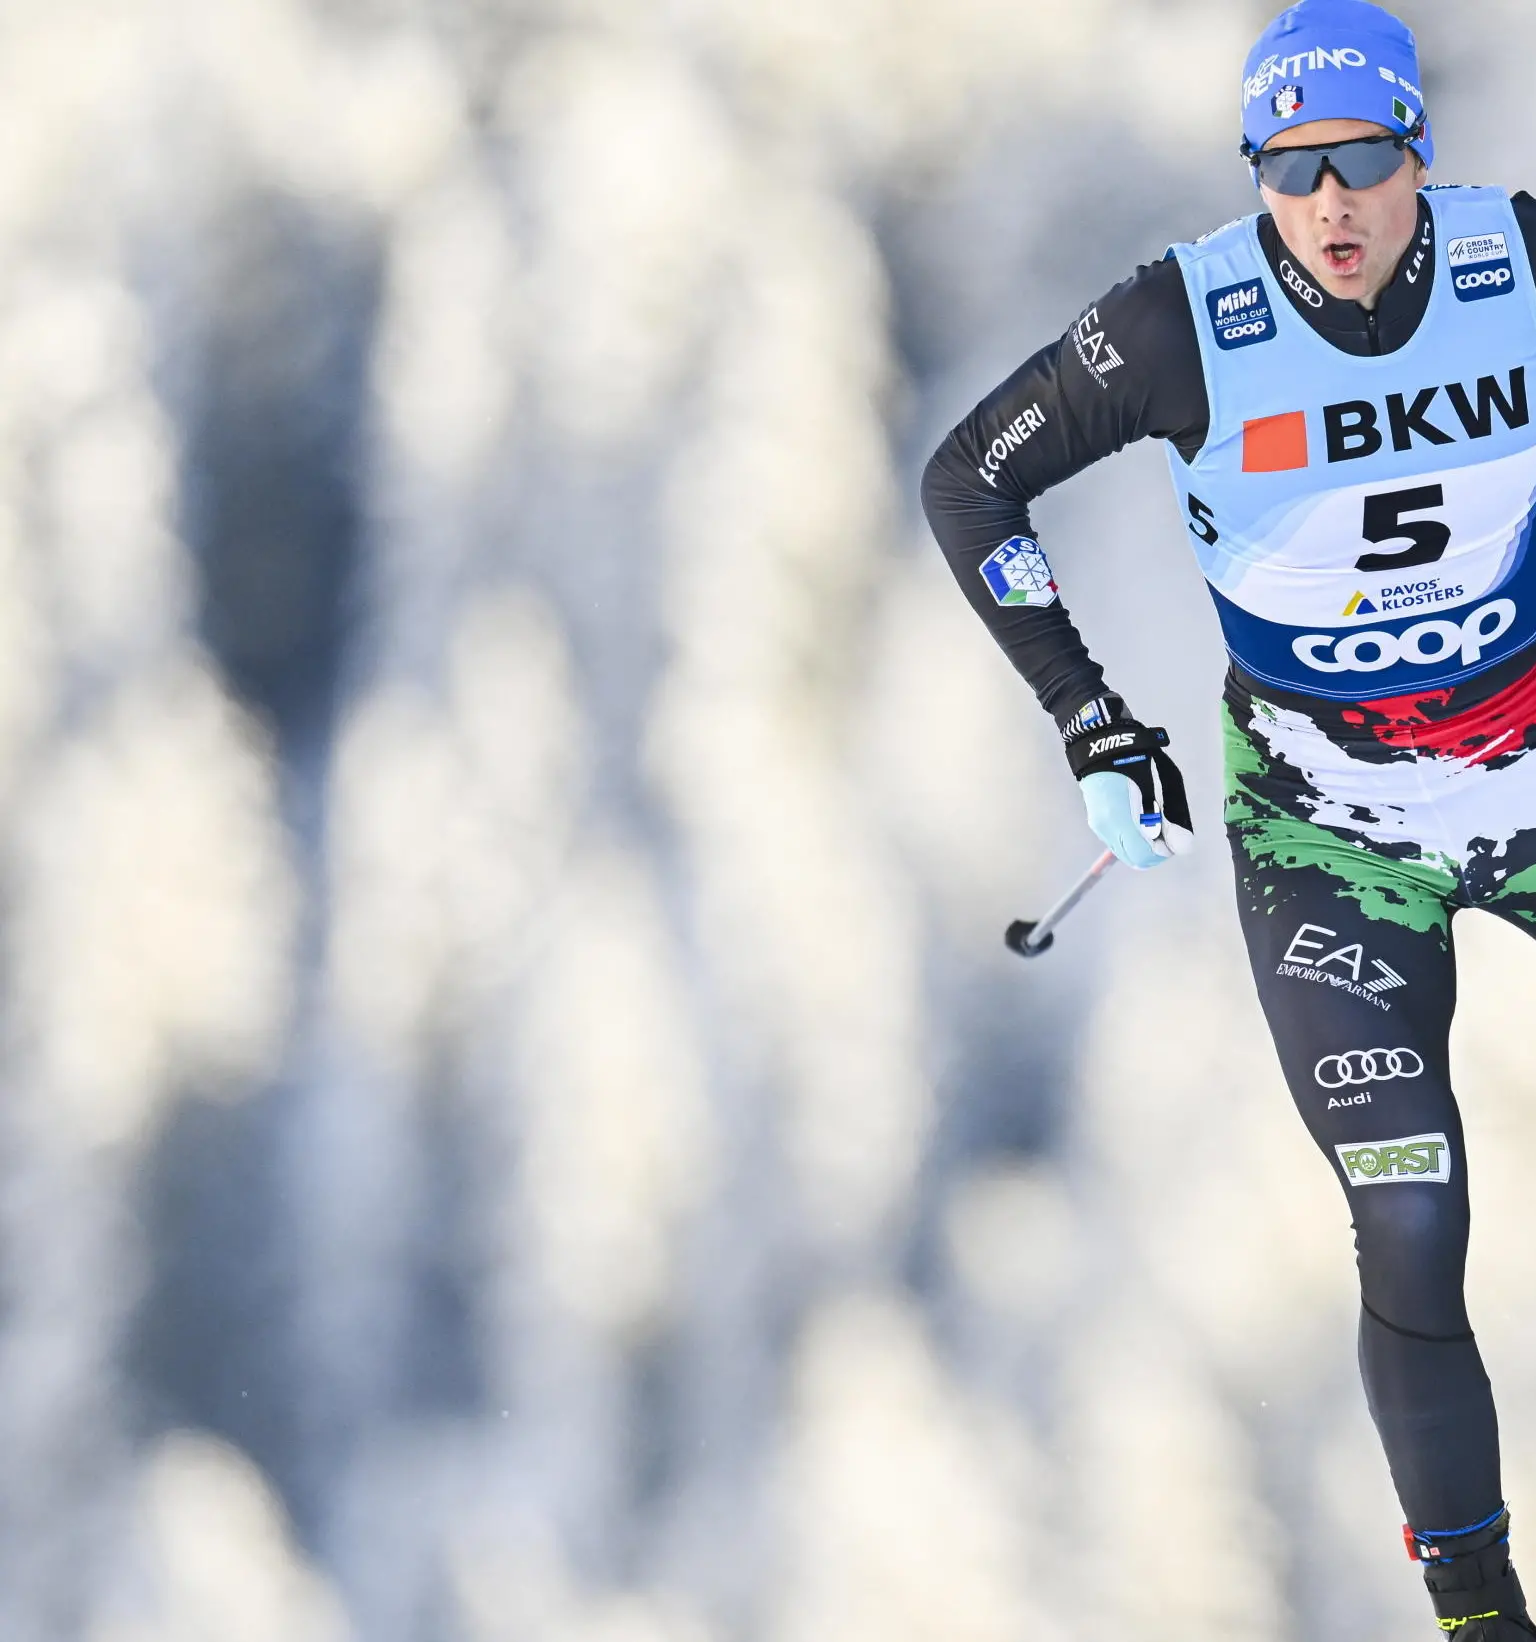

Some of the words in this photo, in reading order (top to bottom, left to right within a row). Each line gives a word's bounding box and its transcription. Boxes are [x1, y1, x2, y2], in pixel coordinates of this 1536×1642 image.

[1243, 46, 1366, 109] TRENTINO
[1466, 239, 1493, 248] CROSS
[1467, 243, 1504, 255] COUNTRY
[1455, 267, 1511, 290] coop
[1215, 312, 1247, 326] WORLD
[1249, 307, 1268, 318] CUP
[1223, 320, 1266, 340] coop
[1078, 307, 1124, 374] EA7
[1322, 366, 1530, 463] BKW
[1188, 492, 1219, 546] 5
[1354, 483, 1452, 572] 5
[1382, 585, 1464, 611] KLOSTERS
[1291, 598, 1516, 673] coop
[1284, 923, 1407, 993] EA7
[1276, 963, 1328, 983] EMPORIO
[1341, 980, 1391, 1011] ARMANI
[1327, 1091, 1371, 1109] Audi
[1341, 1142, 1445, 1178] FORST
